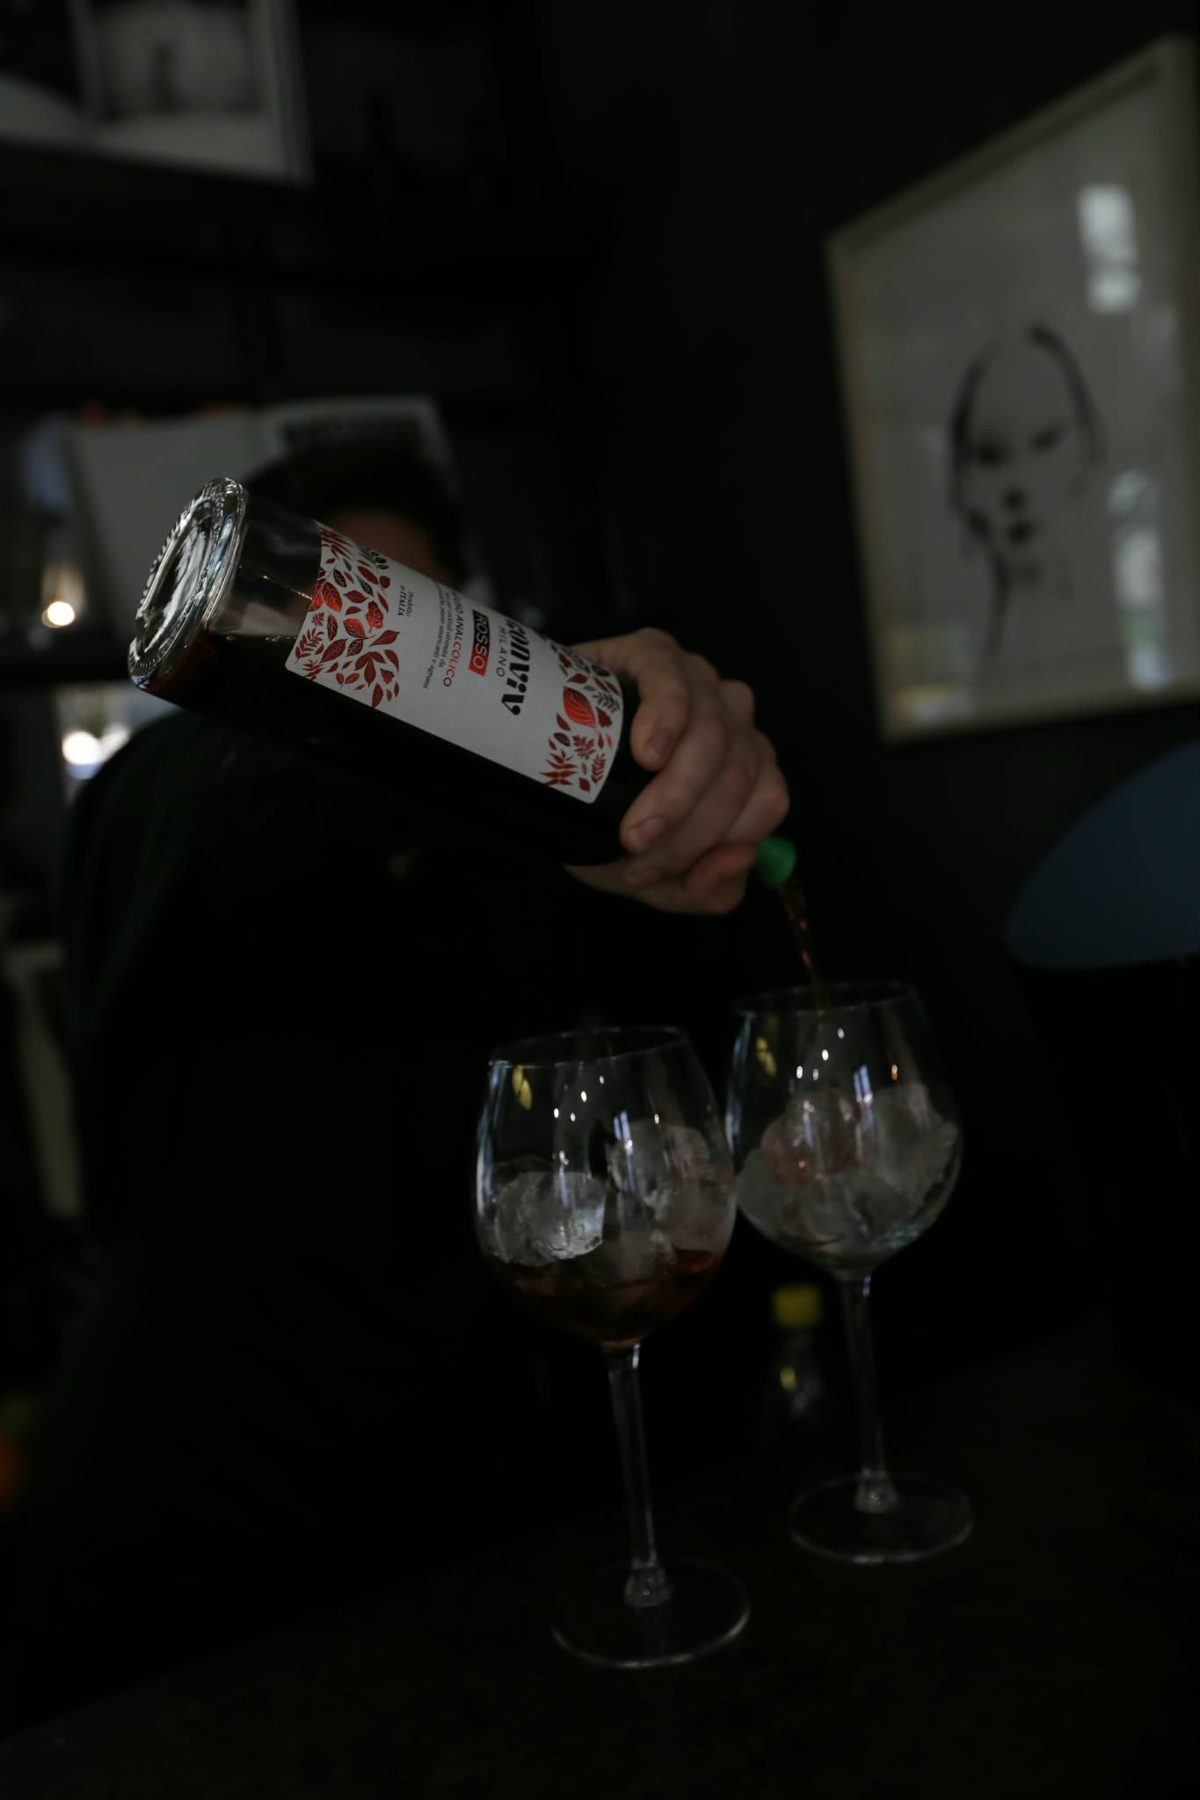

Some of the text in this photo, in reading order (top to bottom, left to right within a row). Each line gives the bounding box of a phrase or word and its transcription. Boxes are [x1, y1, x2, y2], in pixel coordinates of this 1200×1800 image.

[398, 592, 407, 616] ITALIA
[443, 615, 464, 687] ANALCOLICO
[472, 612, 489, 670] ROSSO
[496, 626, 508, 677] MILANO
